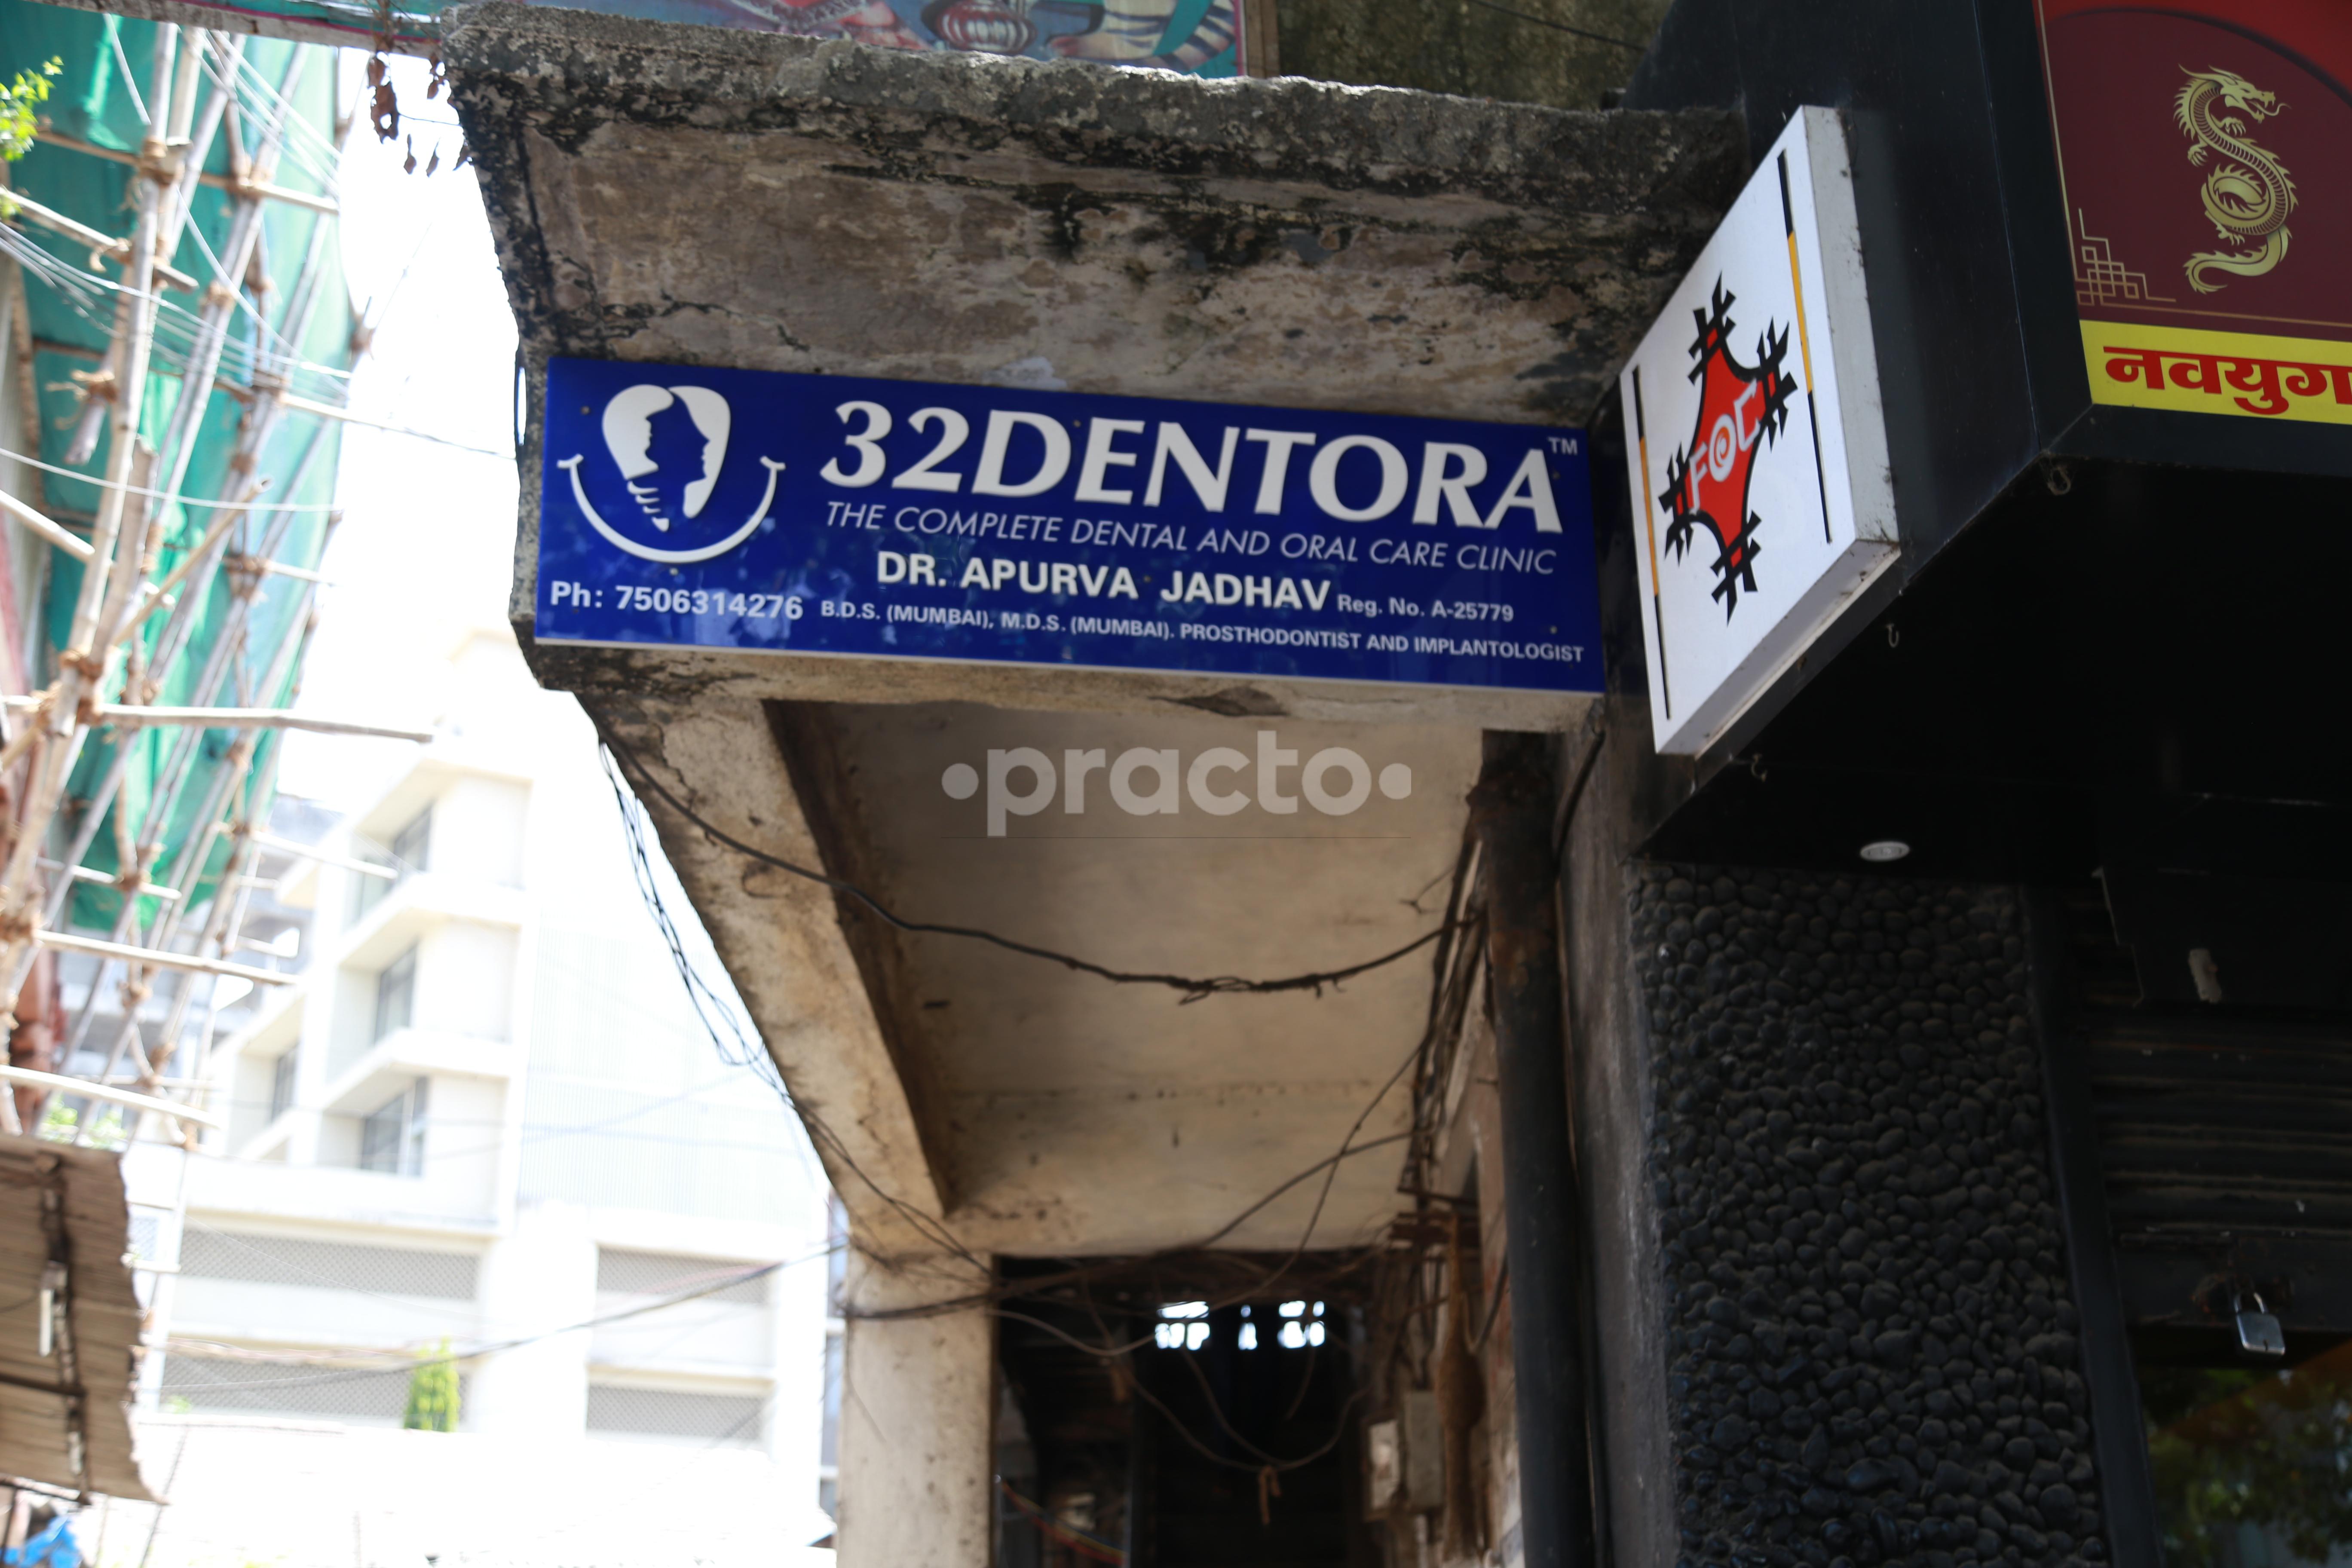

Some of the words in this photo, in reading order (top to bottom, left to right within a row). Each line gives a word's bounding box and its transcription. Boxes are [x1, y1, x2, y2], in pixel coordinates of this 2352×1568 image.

[820, 401, 1562, 533] 32DENTORA
[826, 502, 885, 529] THE
[894, 507, 1063, 542] COMPLETE
[1071, 519, 1187, 551] DENTAL
[1197, 529, 1269, 556] AND
[1280, 534, 1358, 561] ORAL
[1369, 539, 1448, 567] CARE
[1457, 545, 1556, 575] CLINIC
[550, 580, 603, 608] Ph:
[616, 586, 803, 620] 7506314276
[878, 551, 946, 587] DR.
[960, 557, 1139, 599] APURVA
[1161, 571, 1331, 610] JADHAV
[1337, 594, 1382, 617] Reg.
[1389, 597, 1425, 617] No.
[1431, 600, 1513, 622] A-25779
[821, 600, 880, 619] B.D.S.
[887, 605, 993, 629] (MUMBAI),
[1001, 612, 1066, 631] M.D.S.
[1181, 623, 1361, 649] PROSTHODONTIST
[1367, 634, 1409, 652] AND
[1414, 637, 1584, 663] IMPLANTOLOGIST
